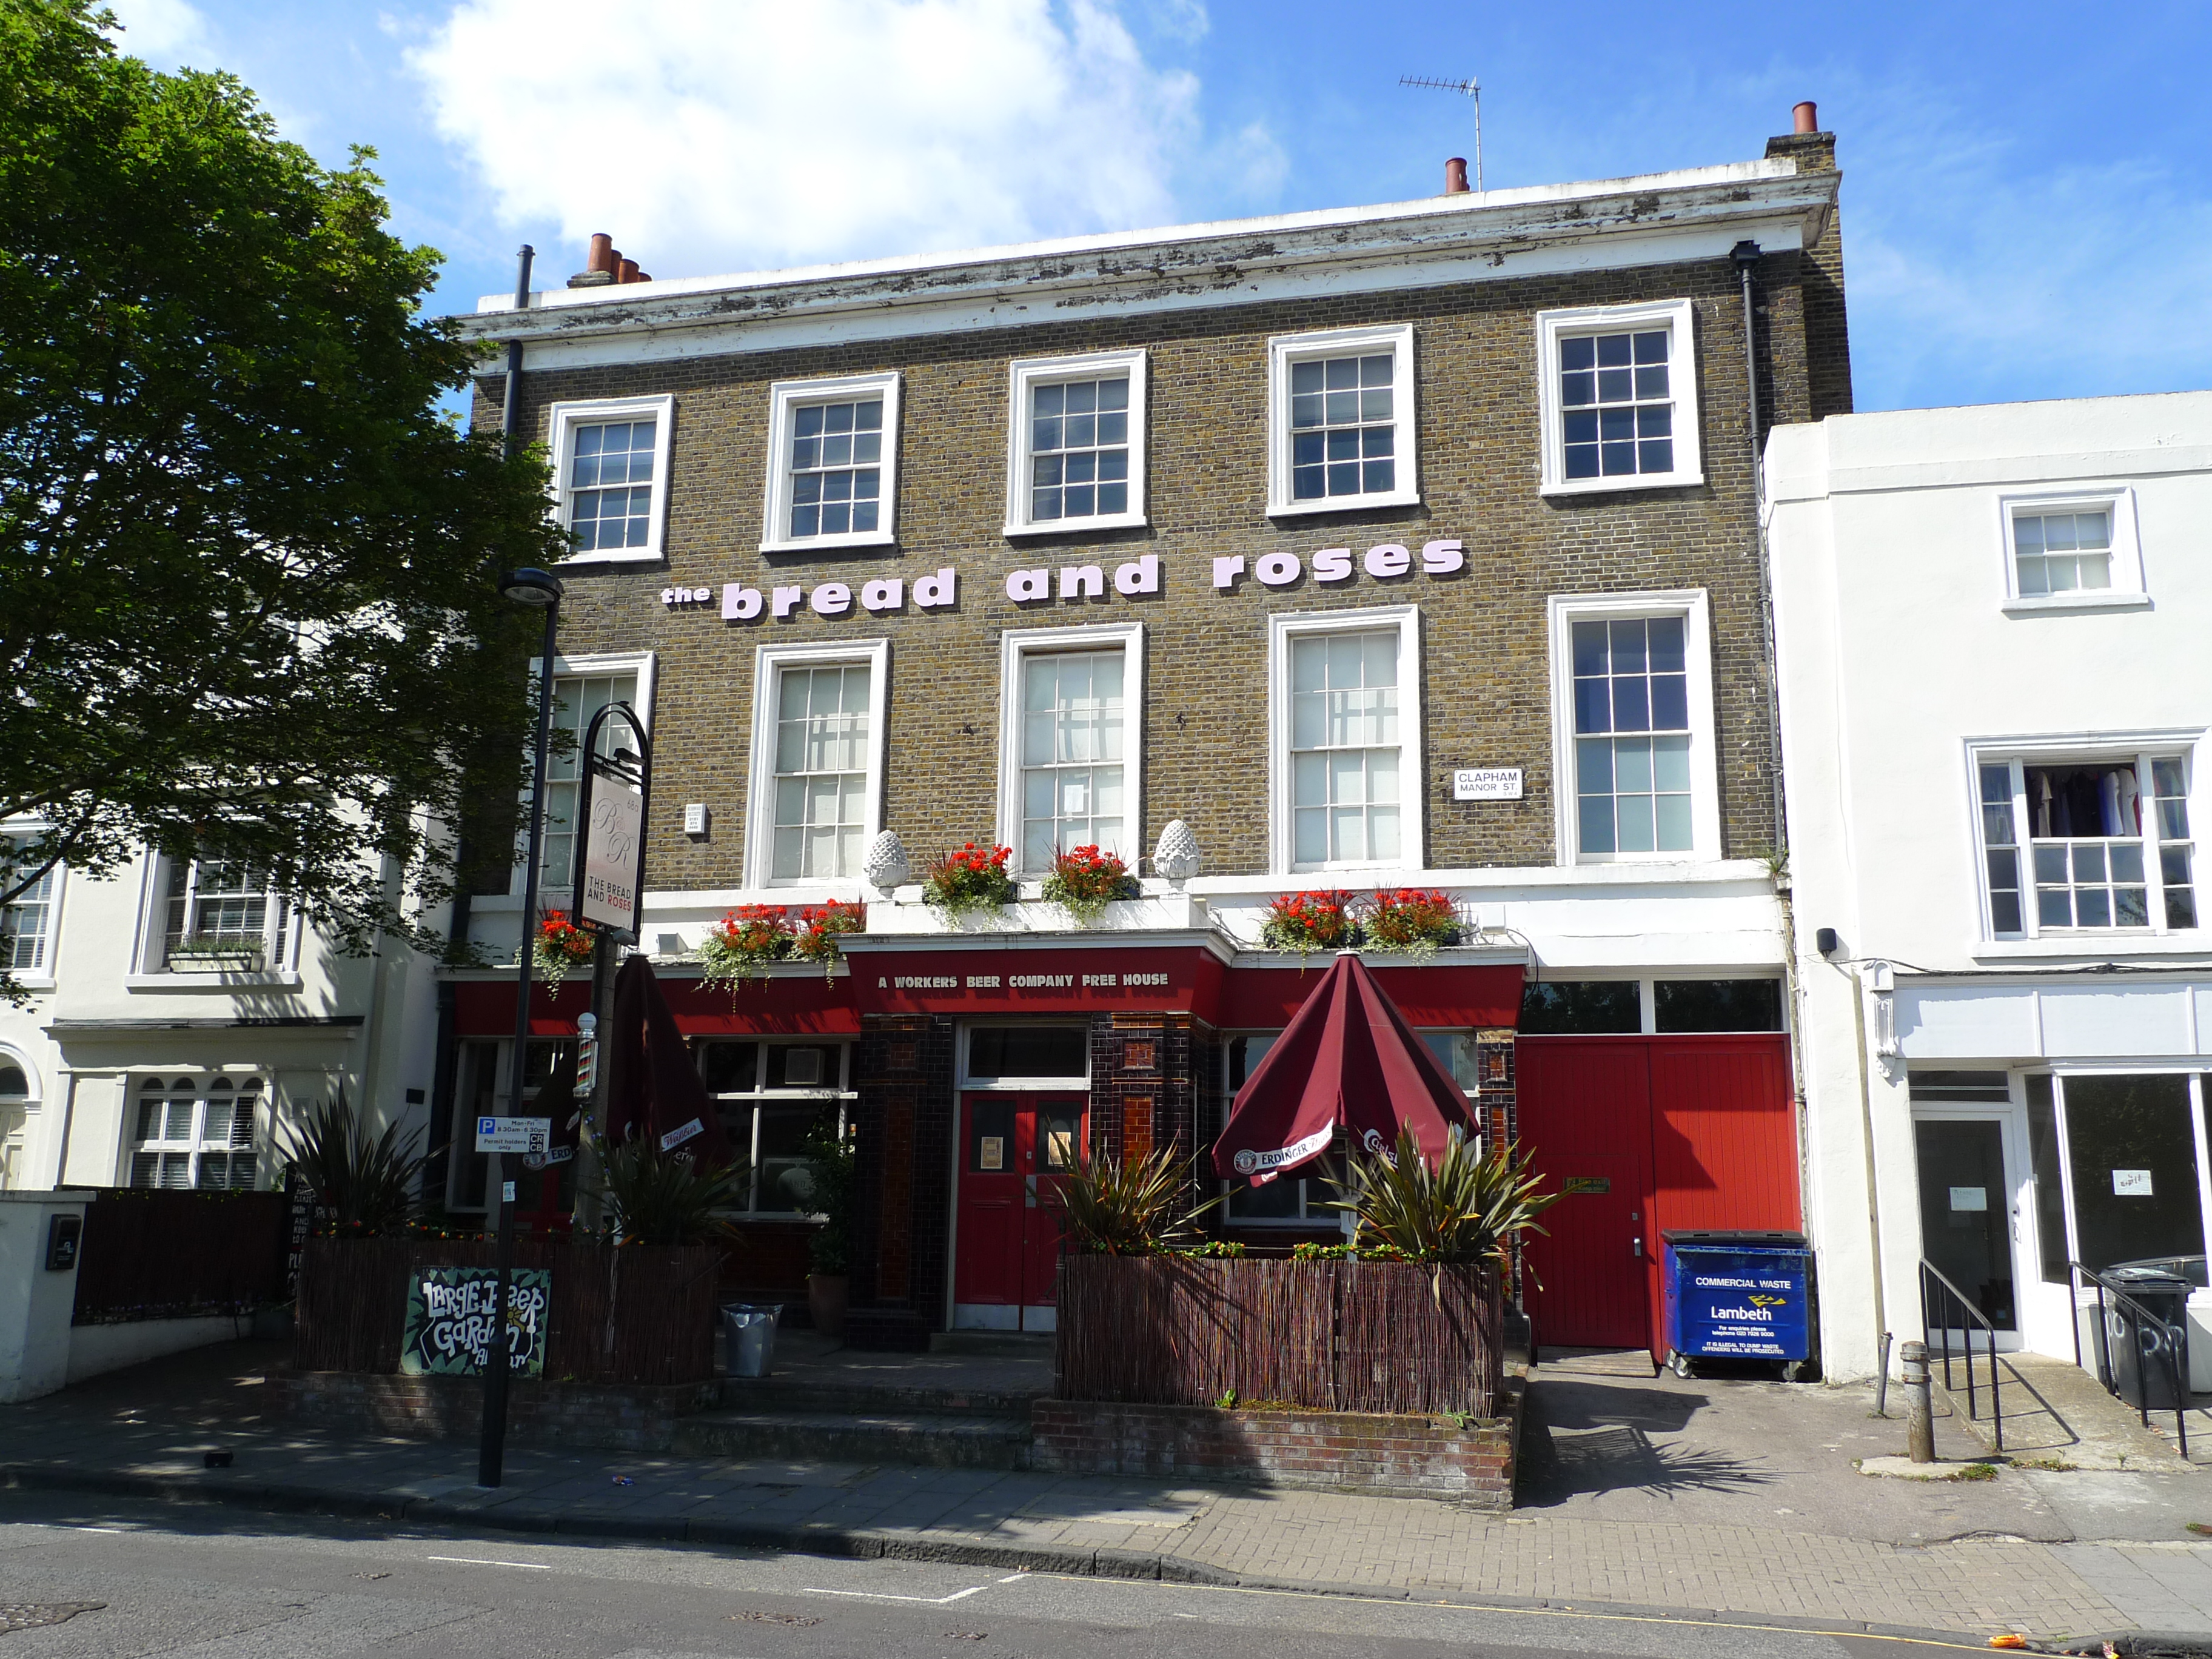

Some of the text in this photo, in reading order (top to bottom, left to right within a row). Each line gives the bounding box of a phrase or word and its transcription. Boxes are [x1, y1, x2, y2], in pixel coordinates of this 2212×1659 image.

[661, 539, 1464, 620] the bread and roses
[1459, 772, 1517, 782] CLAPHAM
[627, 799, 638, 813] 68a
[589, 876, 631, 900] THE BREAD
[588, 888, 631, 912] AND ROSES
[878, 973, 1168, 988] A WORKERS BEER COMPANY FREE HOUSE
[483, 1120, 494, 1133] P
[1262, 1143, 1309, 1165] ERDINGER
[1696, 1277, 1791, 1289] COMMERCIAL WASTE
[1711, 1305, 1772, 1321] Lambeth
